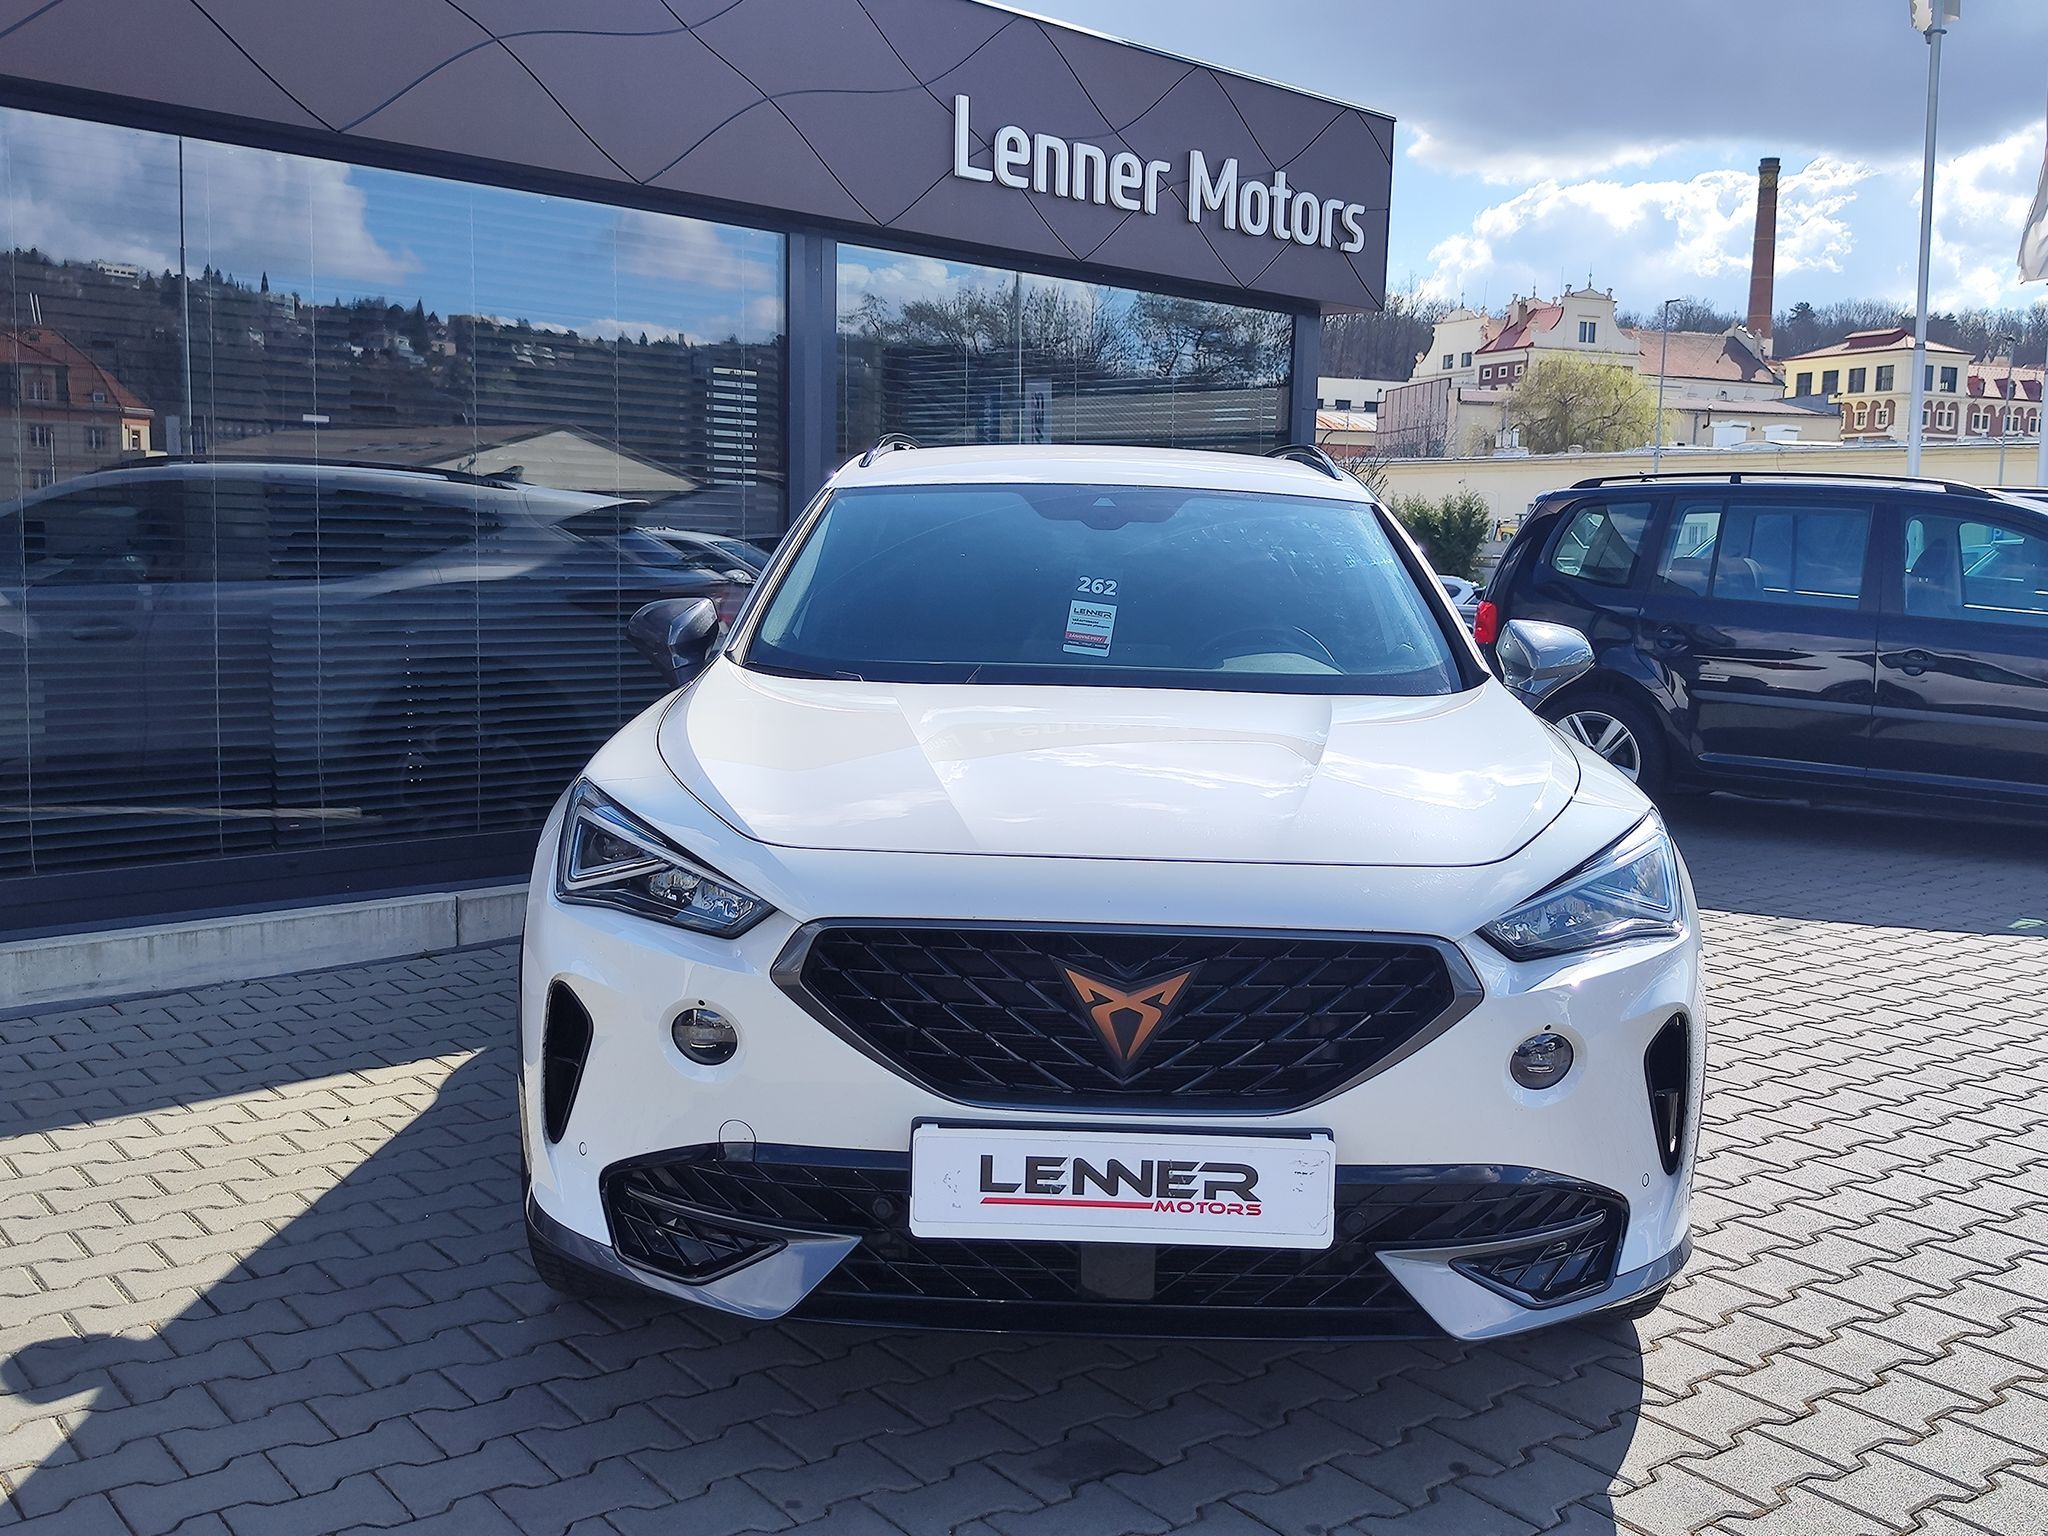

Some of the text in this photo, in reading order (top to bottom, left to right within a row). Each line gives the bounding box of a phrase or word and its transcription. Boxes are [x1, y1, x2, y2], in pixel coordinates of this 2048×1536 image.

[954, 94, 1366, 253] Lenner Motors
[1077, 576, 1117, 596] 262
[1073, 607, 1112, 619] LENNER
[980, 1154, 1262, 1203] LENNER
[1153, 1199, 1262, 1217] MOTORS
